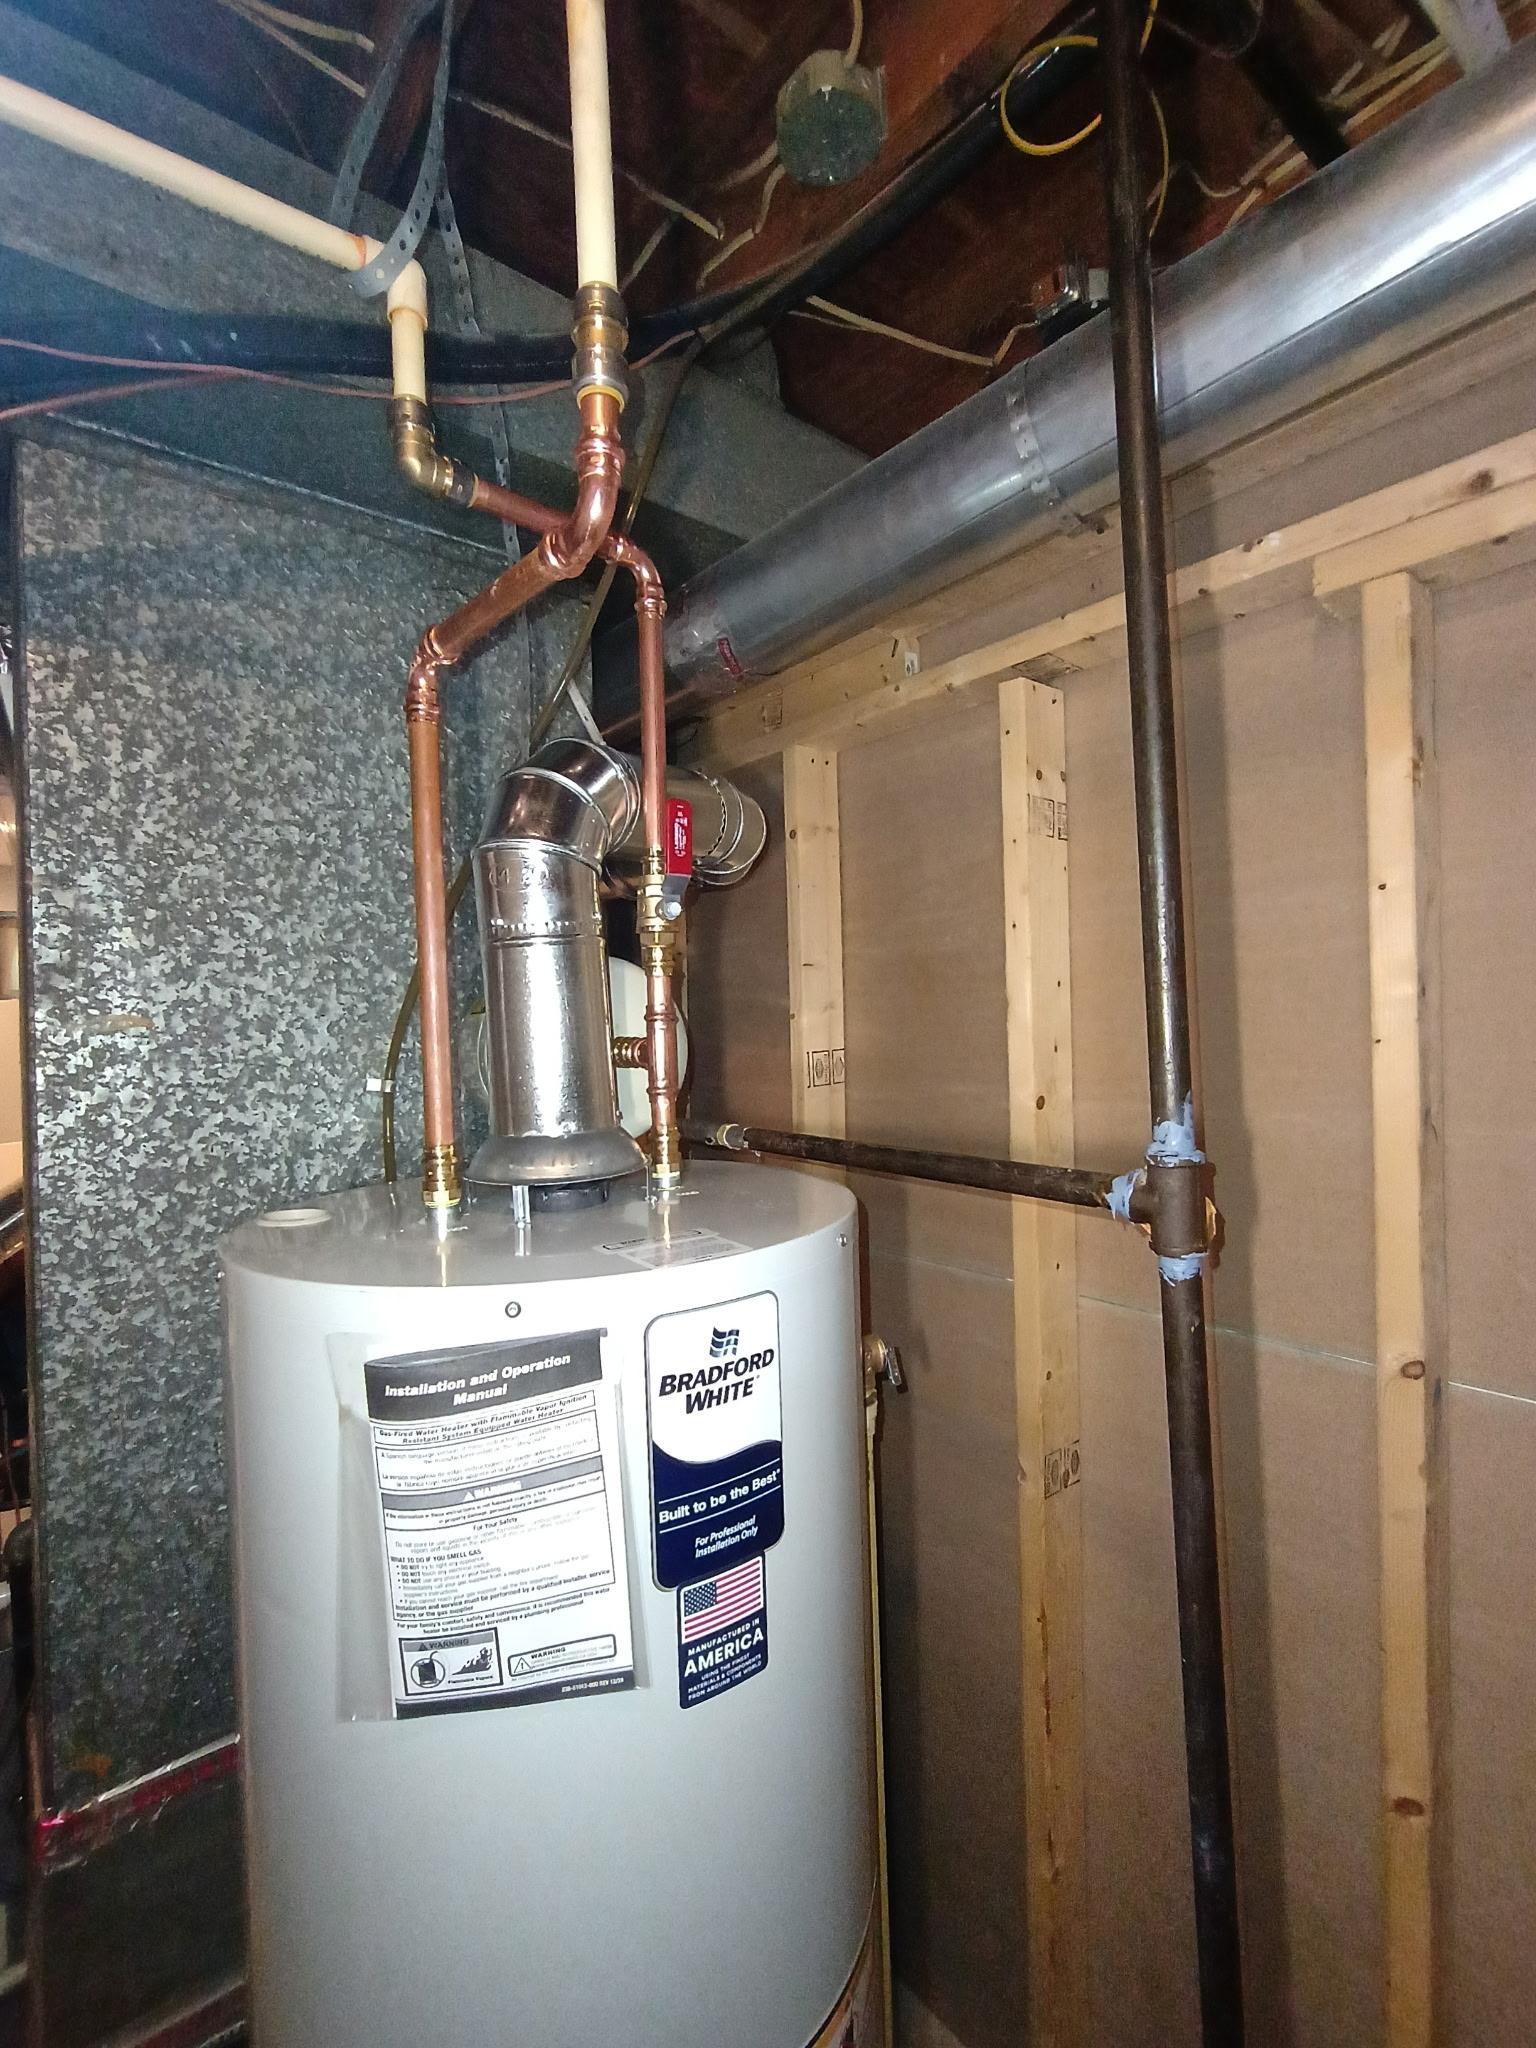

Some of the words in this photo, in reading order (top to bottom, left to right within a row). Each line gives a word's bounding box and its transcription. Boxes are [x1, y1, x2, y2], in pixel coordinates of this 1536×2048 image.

[385, 1379, 466, 1396] Installation
[470, 1369, 498, 1386] and
[502, 1355, 570, 1378] Operation
[658, 1348, 774, 1397] BRADFORD
[453, 1384, 508, 1406] Manual
[658, 1506, 690, 1524] Built
[692, 1500, 707, 1513] to
[710, 1492, 727, 1508] be
[730, 1483, 750, 1500] the
[694, 1532, 710, 1548] For
[710, 1515, 756, 1545] Professional
[695, 1535, 740, 1558] Installation
[740, 1526, 758, 1544] Only
[752, 1618, 760, 1626] IN
[530, 1647, 566, 1659] WARNING
[684, 1628, 764, 1677] AMERICA
